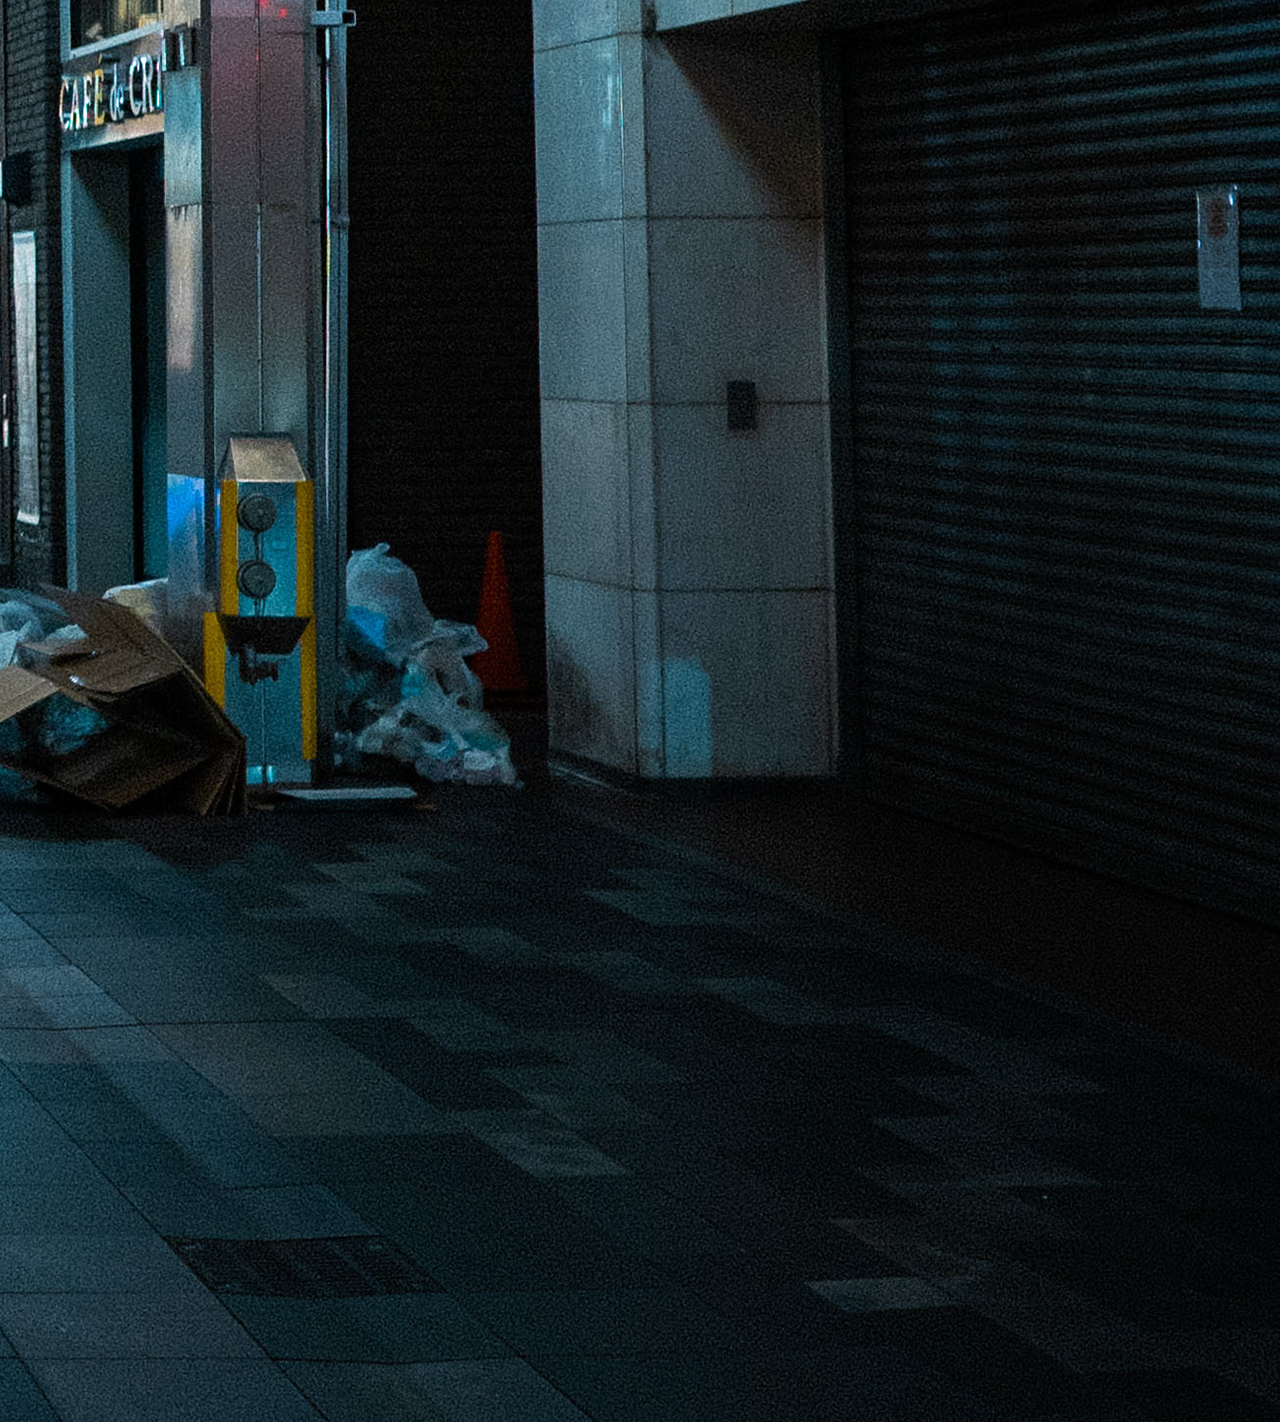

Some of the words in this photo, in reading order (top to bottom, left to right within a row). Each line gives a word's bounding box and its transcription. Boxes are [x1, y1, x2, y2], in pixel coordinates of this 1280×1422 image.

[58, 53, 106, 131] CAFÉ
[109, 63, 125, 122] de
[128, 53, 163, 118] CRI
